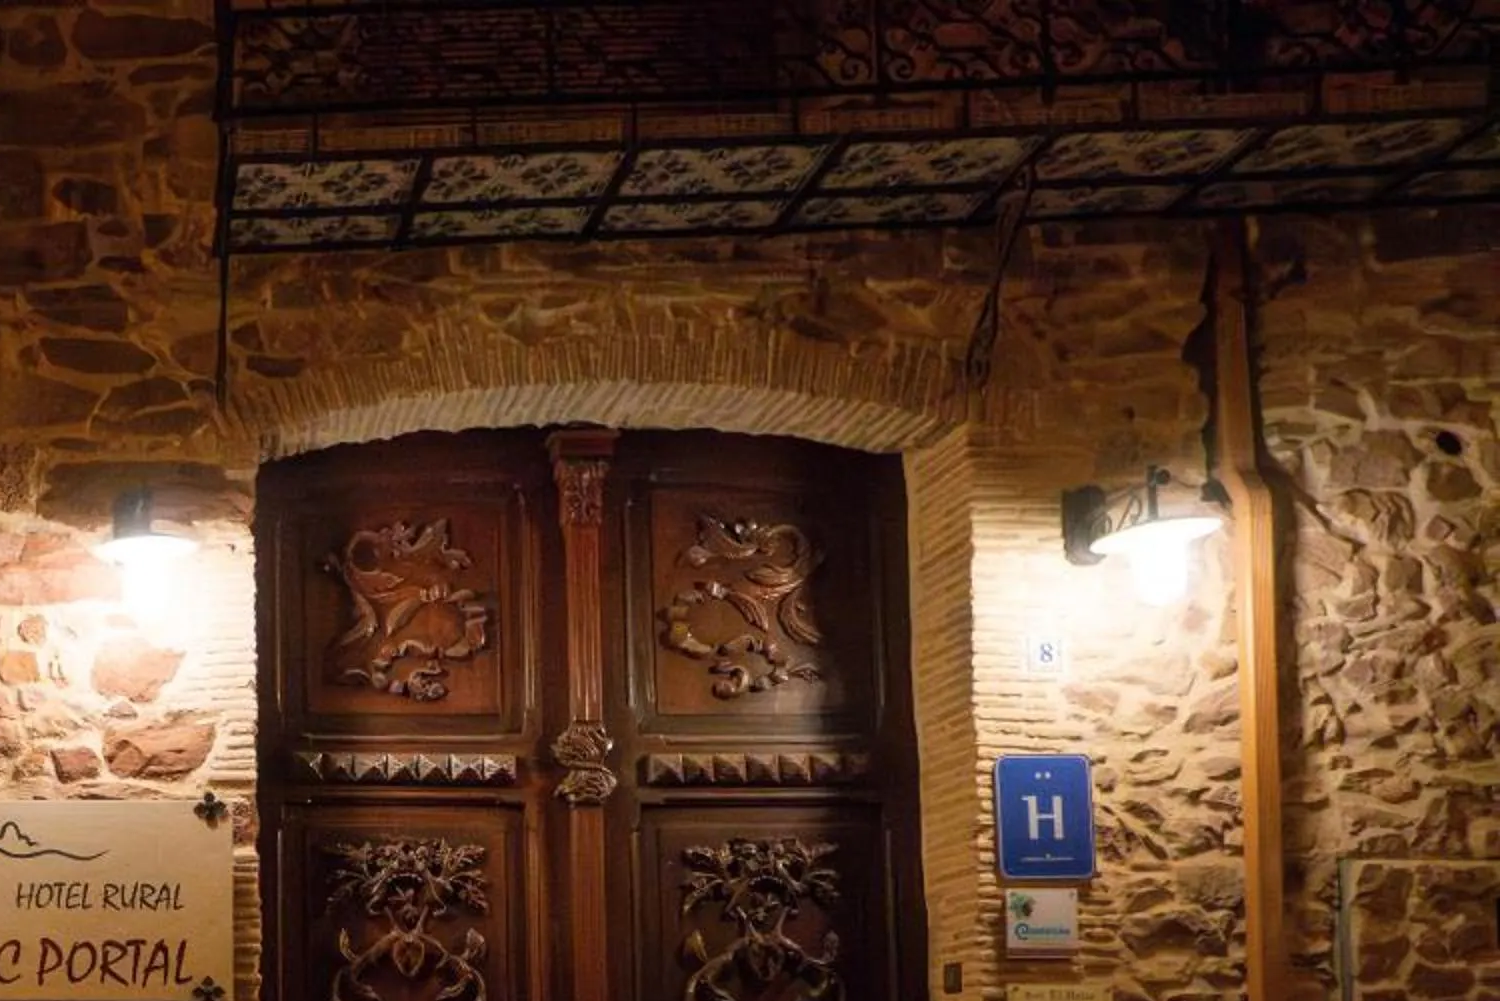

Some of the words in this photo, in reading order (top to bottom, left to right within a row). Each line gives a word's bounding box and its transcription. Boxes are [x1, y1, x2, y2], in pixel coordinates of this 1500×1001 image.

[1040, 643, 1053, 663] 8
[1021, 795, 1064, 840] H
[15, 882, 93, 911] HOTEL
[101, 882, 185, 911] RURAL
[36, 937, 194, 989] PORTAL
